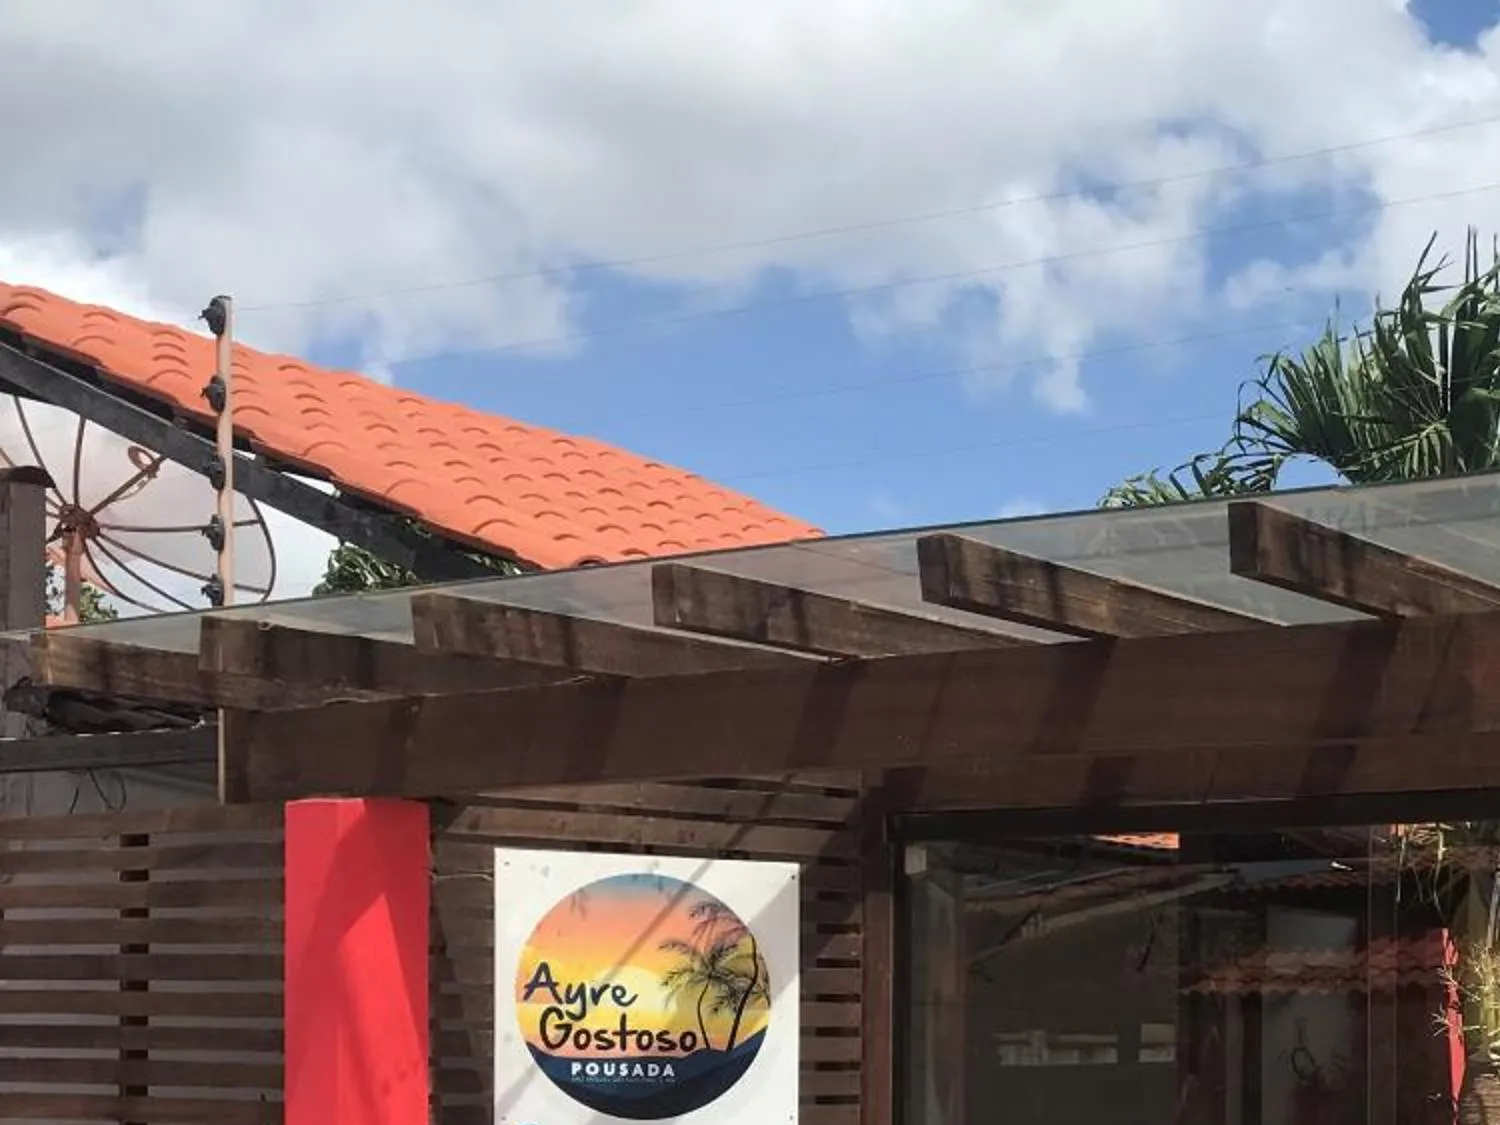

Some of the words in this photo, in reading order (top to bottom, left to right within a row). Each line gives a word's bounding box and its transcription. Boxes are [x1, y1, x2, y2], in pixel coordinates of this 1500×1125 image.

[523, 961, 638, 1021] Ayre
[539, 1006, 698, 1051] Gostoso
[571, 1062, 676, 1077] POUSADA
